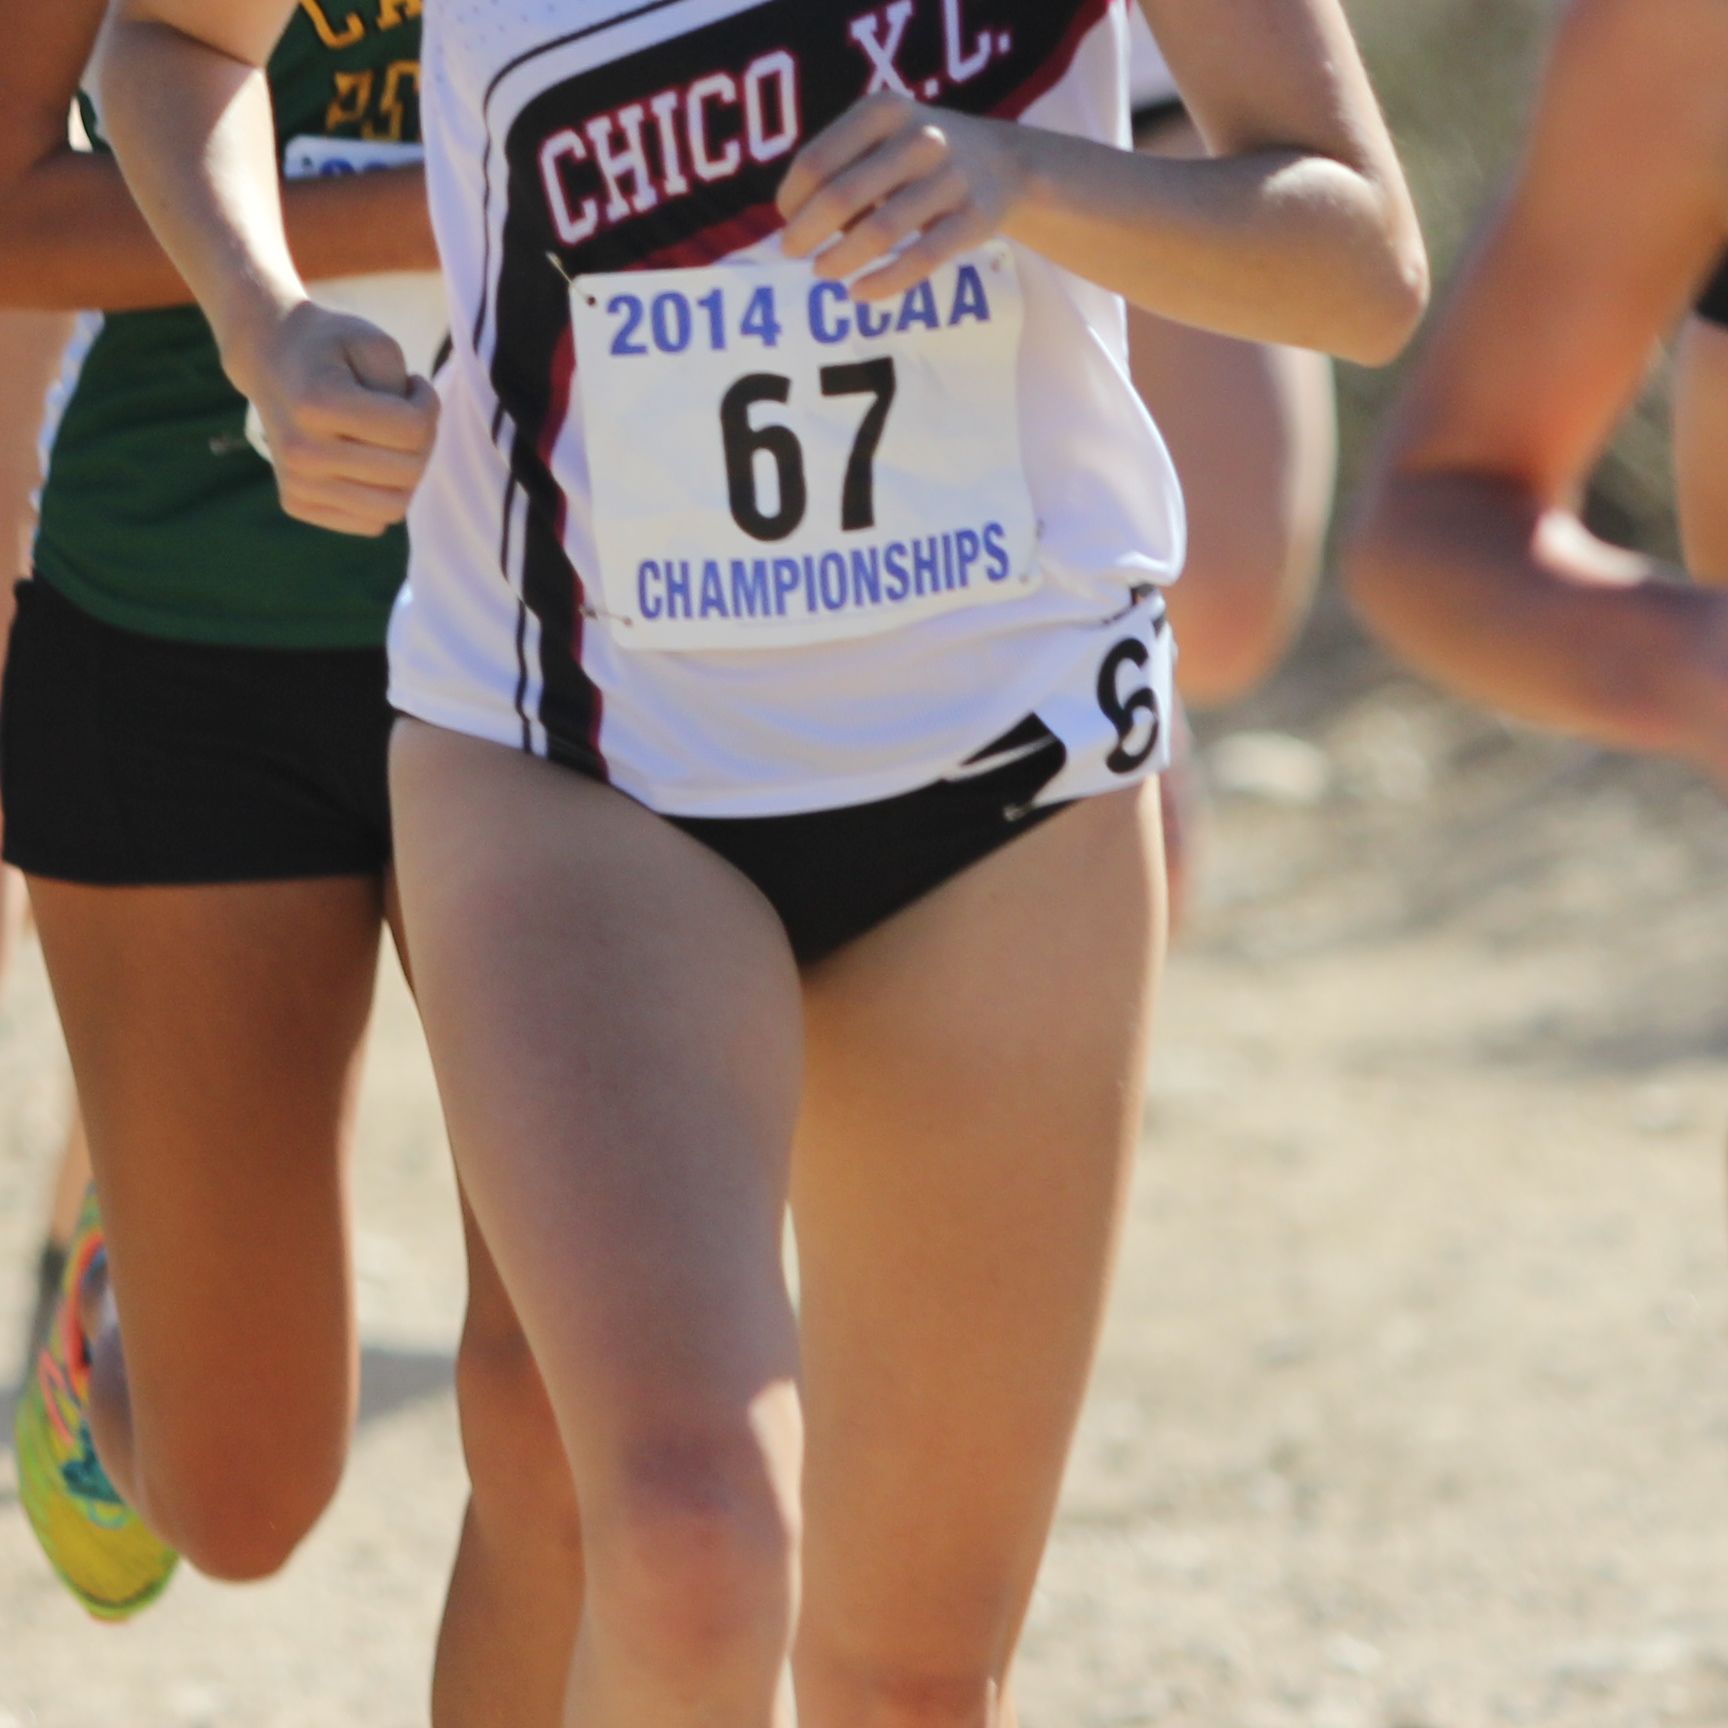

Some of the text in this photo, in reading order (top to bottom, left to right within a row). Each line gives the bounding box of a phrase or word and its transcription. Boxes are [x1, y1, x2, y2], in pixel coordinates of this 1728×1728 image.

[539, 48, 802, 248] CHICO
[606, 263, 992, 357] 2014 CCAA
[719, 355, 897, 543] 67
[636, 520, 1012, 621] CHAMPIONSHIPS
